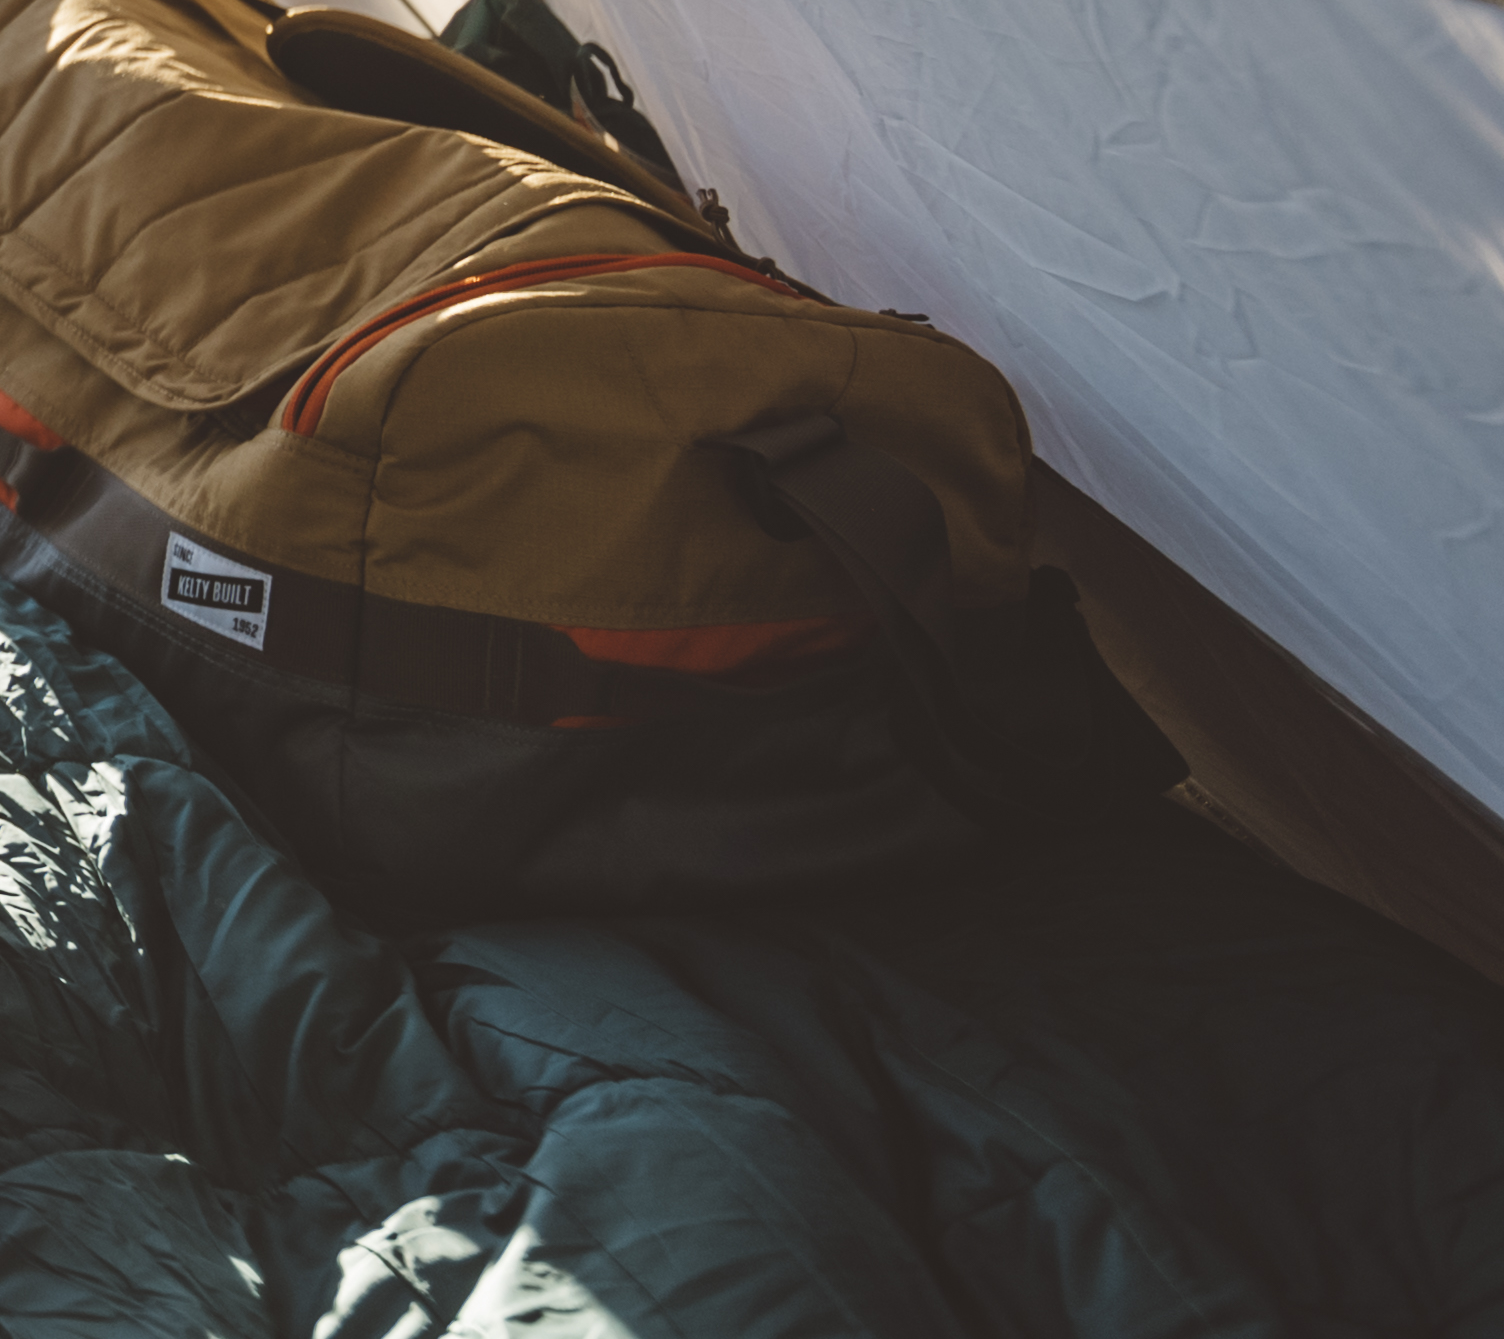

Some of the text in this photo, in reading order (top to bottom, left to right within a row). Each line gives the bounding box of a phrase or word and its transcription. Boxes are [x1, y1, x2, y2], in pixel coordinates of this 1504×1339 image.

[173, 543, 194, 565] SINCE
[177, 575, 252, 606] KELTY BUILT
[232, 617, 259, 638] 1952
